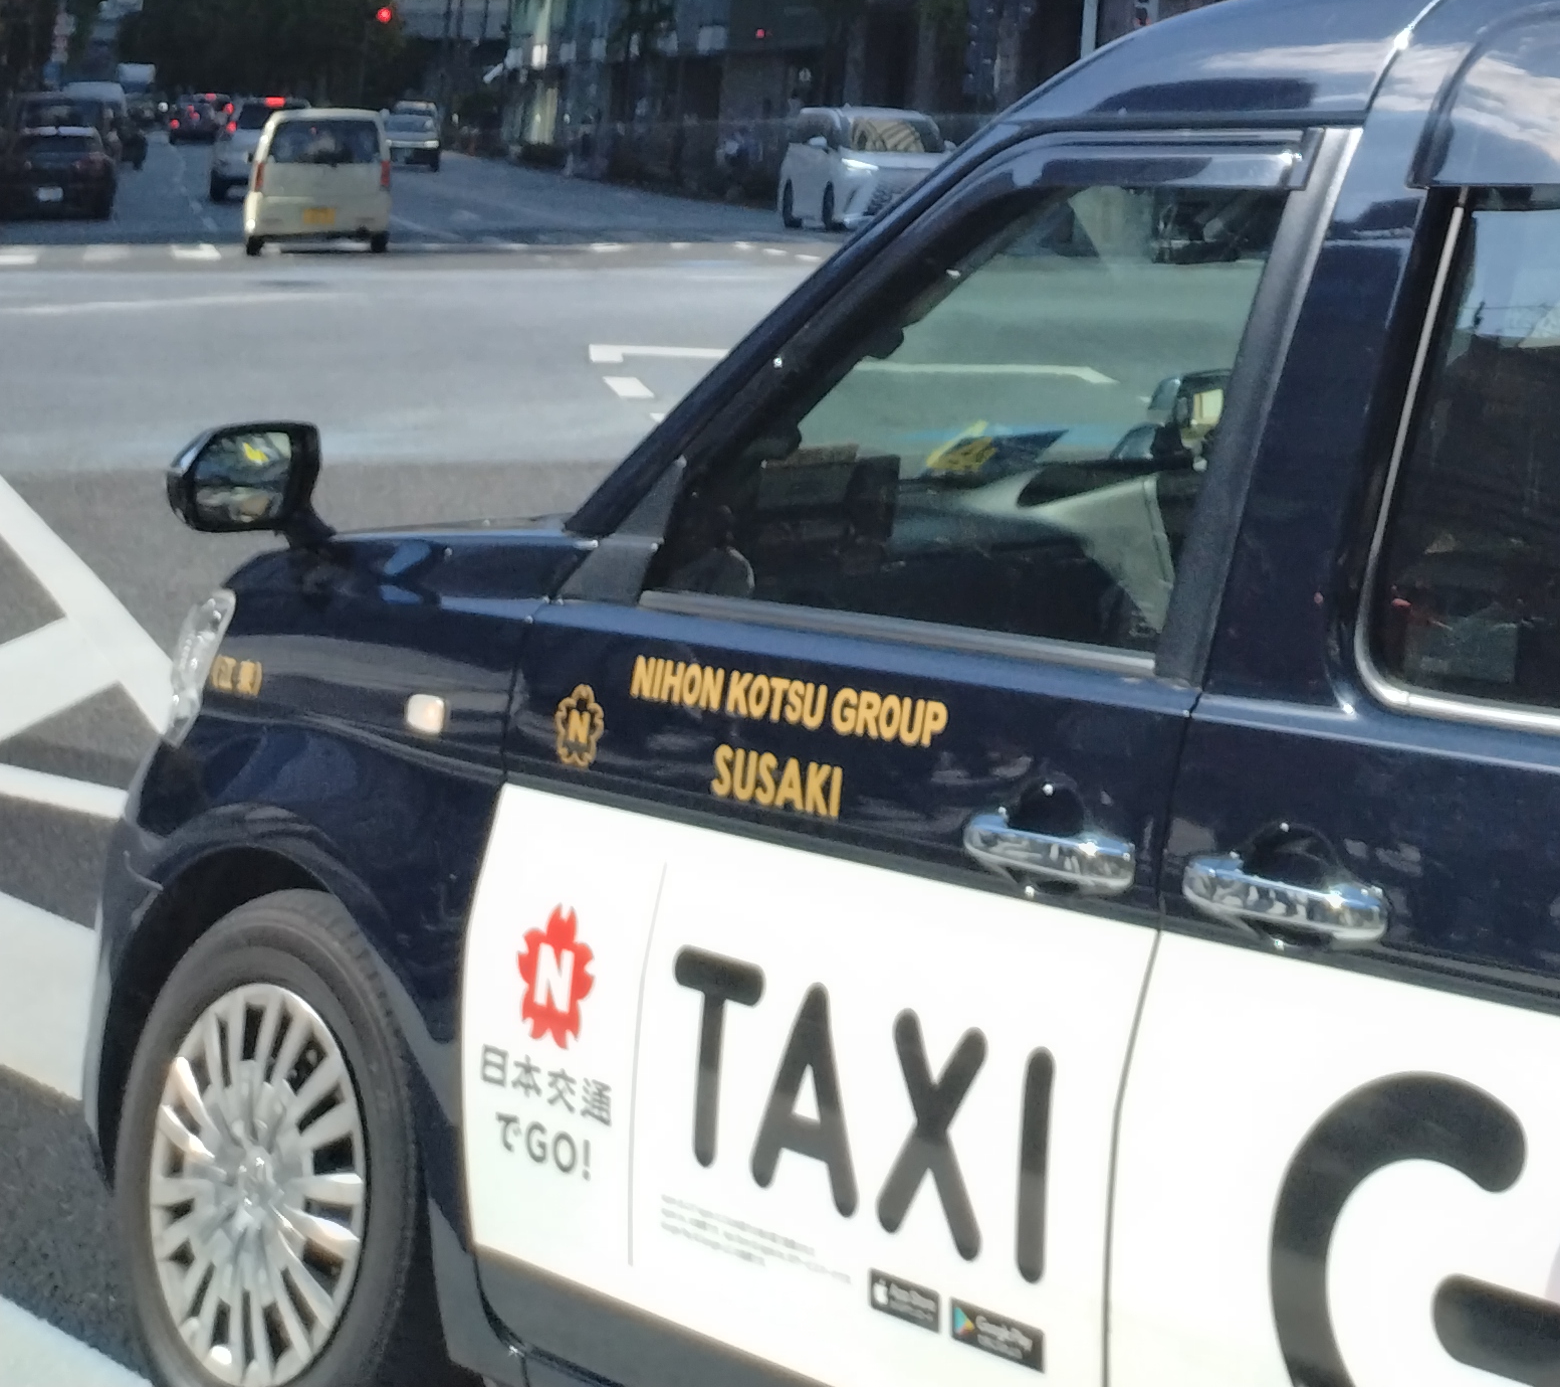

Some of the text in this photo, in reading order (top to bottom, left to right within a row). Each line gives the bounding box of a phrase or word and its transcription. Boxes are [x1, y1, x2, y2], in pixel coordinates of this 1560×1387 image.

[630, 654, 950, 748] NIHON KOTSU GROUP
[711, 743, 844, 820] SUSAKI
[480, 1043, 612, 1127] 日本交通
[673, 944, 1055, 1284] TAXI
[495, 1111, 592, 1182] でGO!
